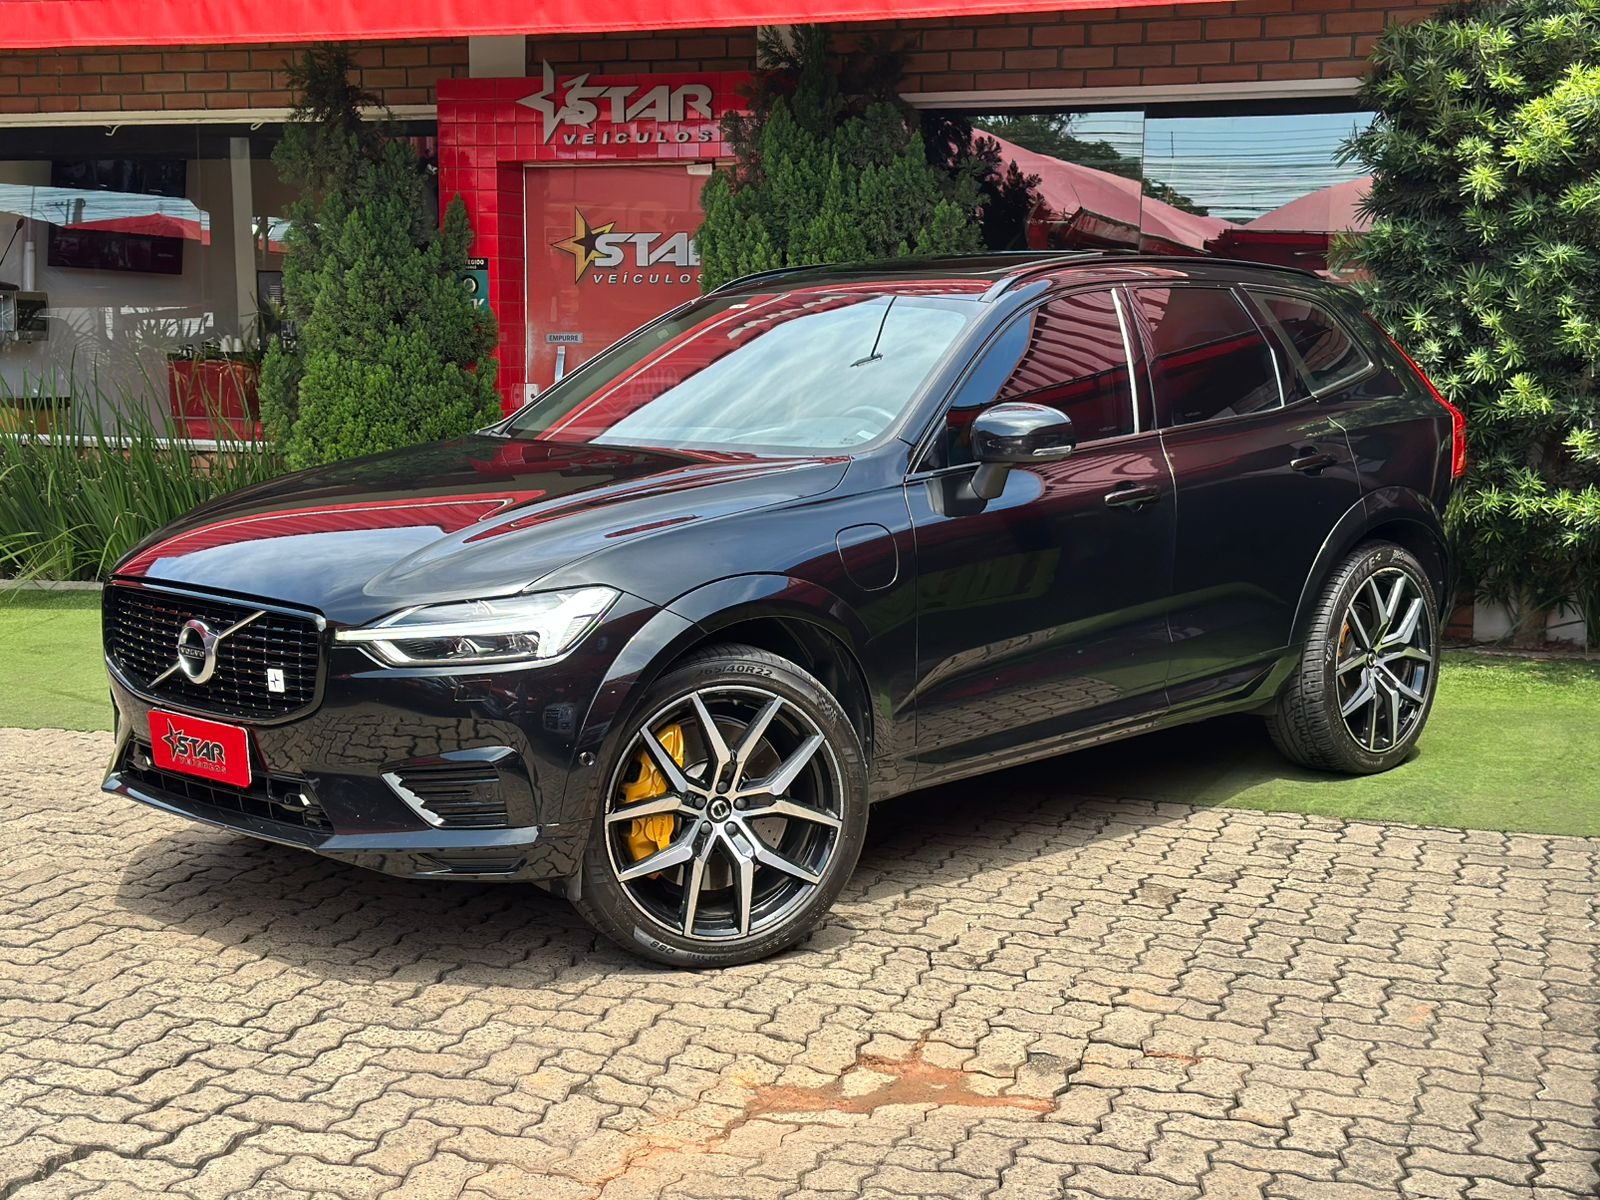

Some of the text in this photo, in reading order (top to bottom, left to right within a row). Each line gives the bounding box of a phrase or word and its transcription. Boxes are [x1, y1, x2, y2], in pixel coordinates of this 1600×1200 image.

[564, 83, 713, 126] STAR
[563, 130, 713, 145] VEÍCULOS
[549, 334, 579, 342] EMPURRE
[180, 646, 205, 658] VOLVO
[176, 737, 226, 764] STAR
